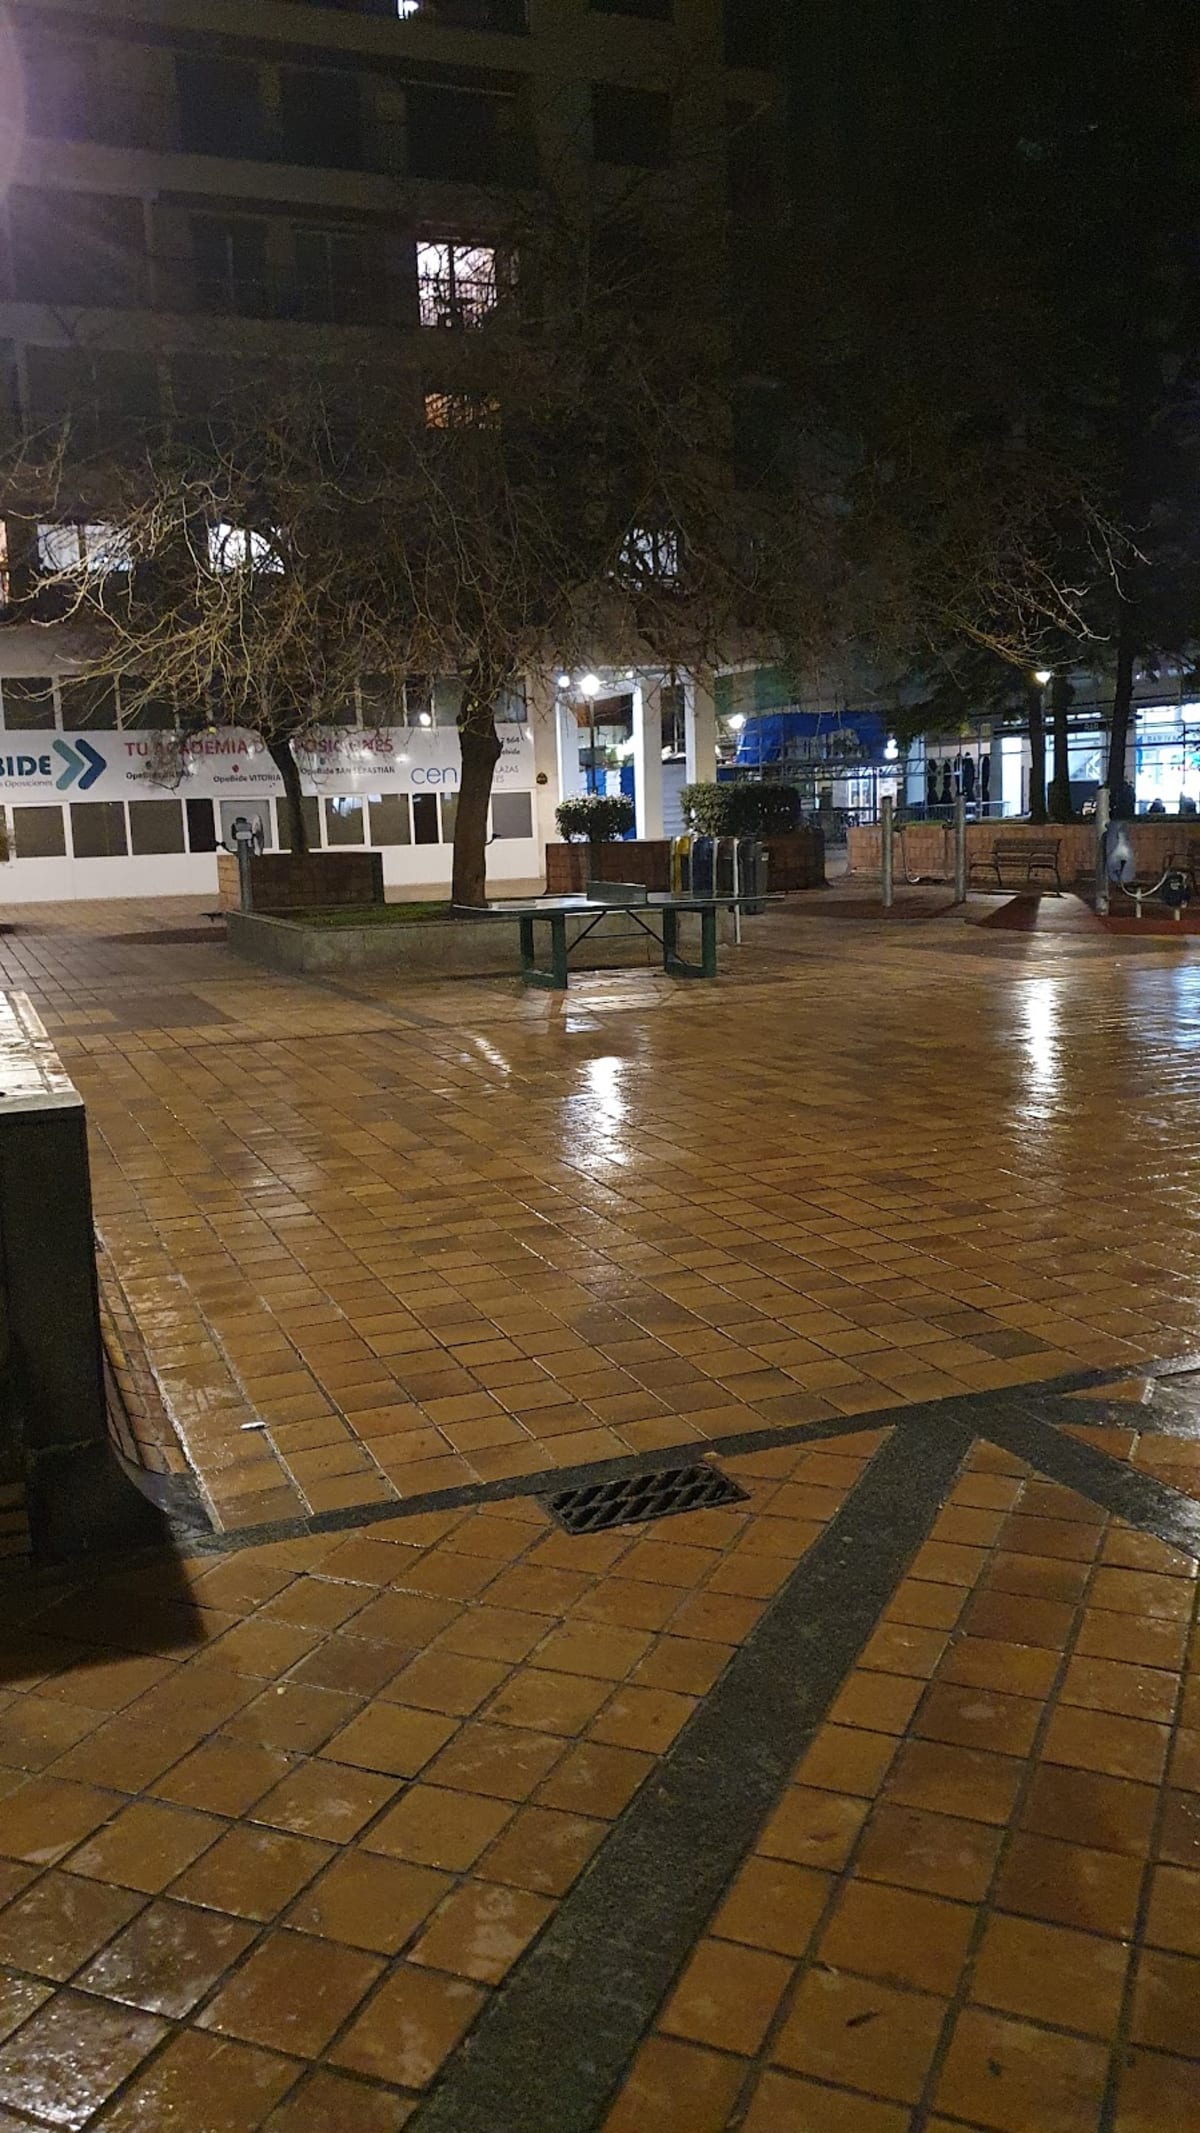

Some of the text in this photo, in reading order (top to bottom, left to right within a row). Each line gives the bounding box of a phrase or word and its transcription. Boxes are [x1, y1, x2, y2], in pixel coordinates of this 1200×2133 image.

[124, 742, 148, 757] TU
[494, 764, 519, 775] LAZAS
[249, 773, 282, 782] VITORIA
